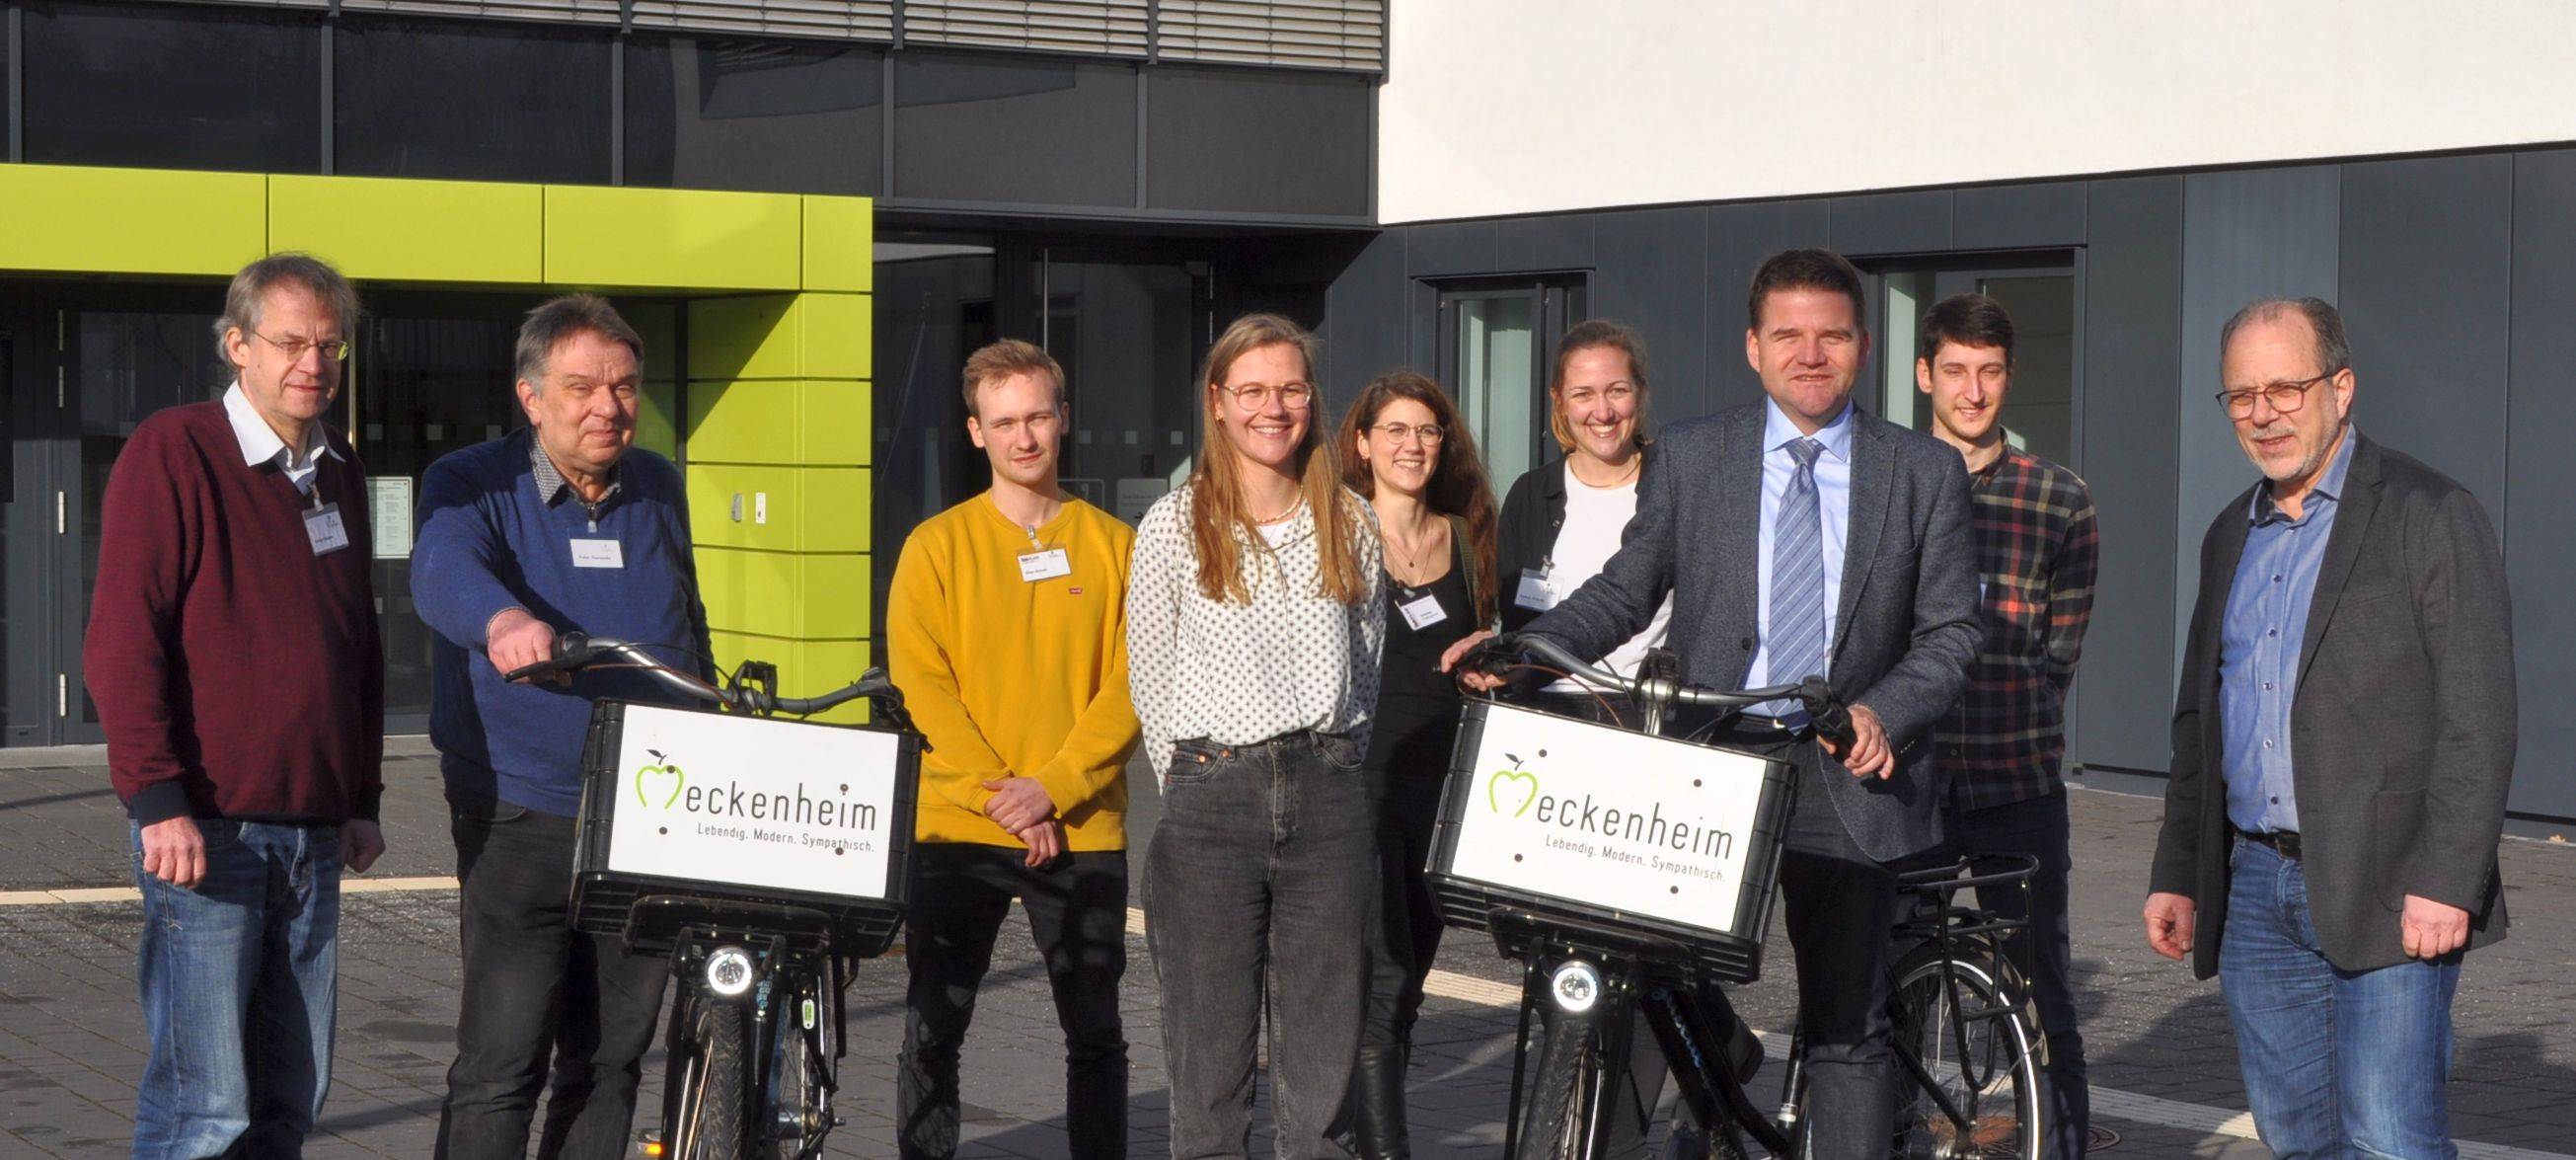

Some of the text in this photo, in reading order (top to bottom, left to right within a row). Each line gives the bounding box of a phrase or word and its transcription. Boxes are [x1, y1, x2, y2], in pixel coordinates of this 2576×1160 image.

[697, 822, 875, 853] Lebendig. Modern. Sympathisch.
[1487, 770, 1734, 861] Meckenheim
[1545, 834, 1727, 883] Lebendig. Modern. Sympathisch.
